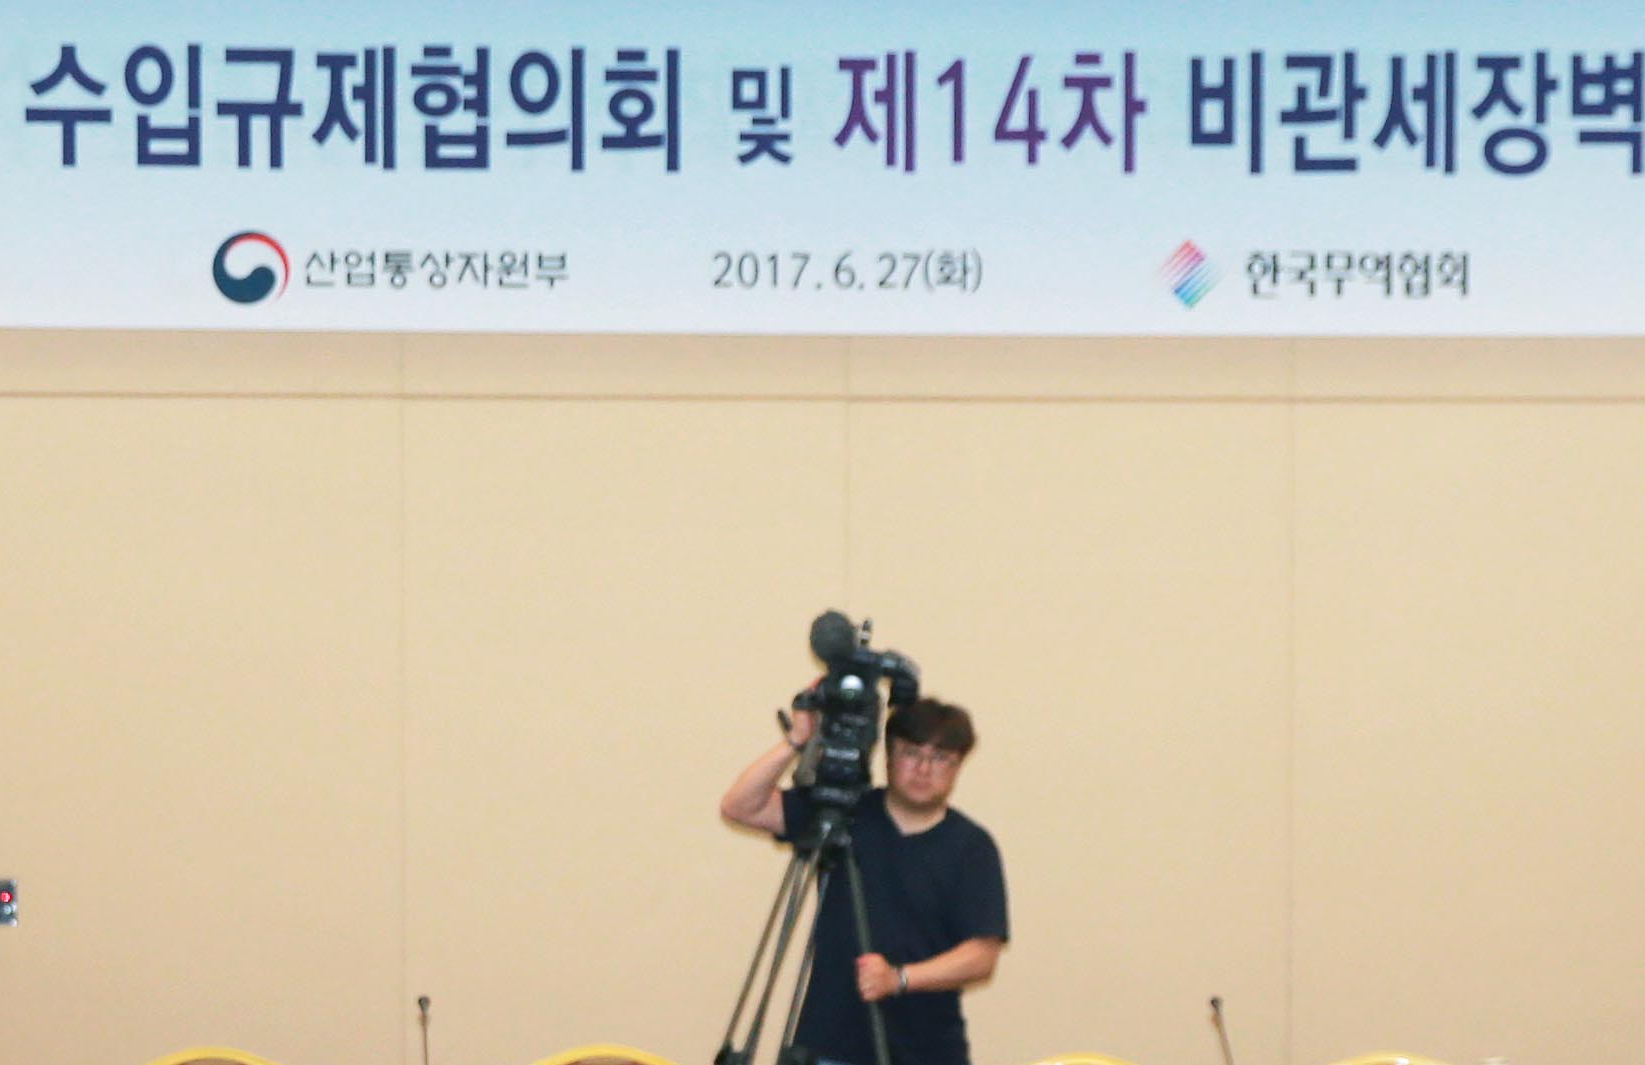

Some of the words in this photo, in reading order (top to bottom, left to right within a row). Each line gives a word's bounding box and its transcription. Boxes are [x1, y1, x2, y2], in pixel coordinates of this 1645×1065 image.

[24, 43, 682, 173] 수입규제협의회
[731, 65, 793, 166] 및
[833, 50, 1148, 174] 제14차
[305, 249, 569, 289] 산업통상자원부
[1246, 250, 1471, 298] 한국무역협회
